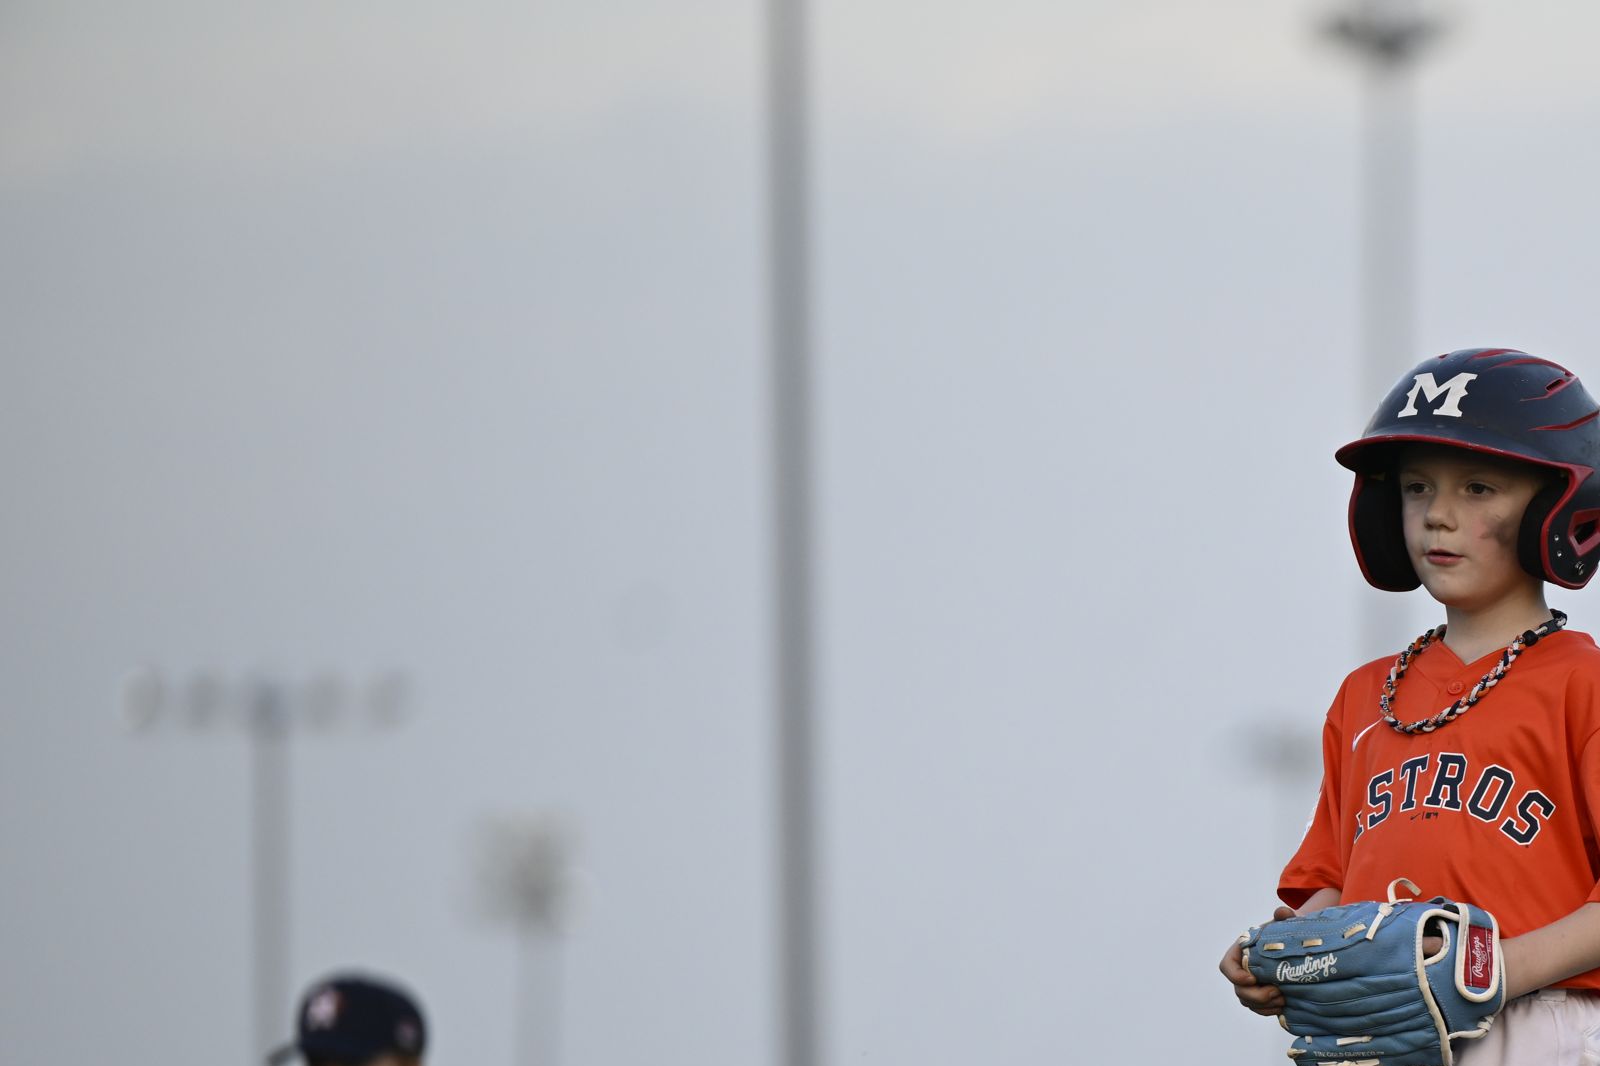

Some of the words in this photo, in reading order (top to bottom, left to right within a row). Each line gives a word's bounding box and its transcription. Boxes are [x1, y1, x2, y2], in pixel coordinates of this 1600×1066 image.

[1396, 372, 1478, 418] M
[1277, 953, 1337, 981] Rawlings
[1472, 936, 1485, 977] Rawlings
